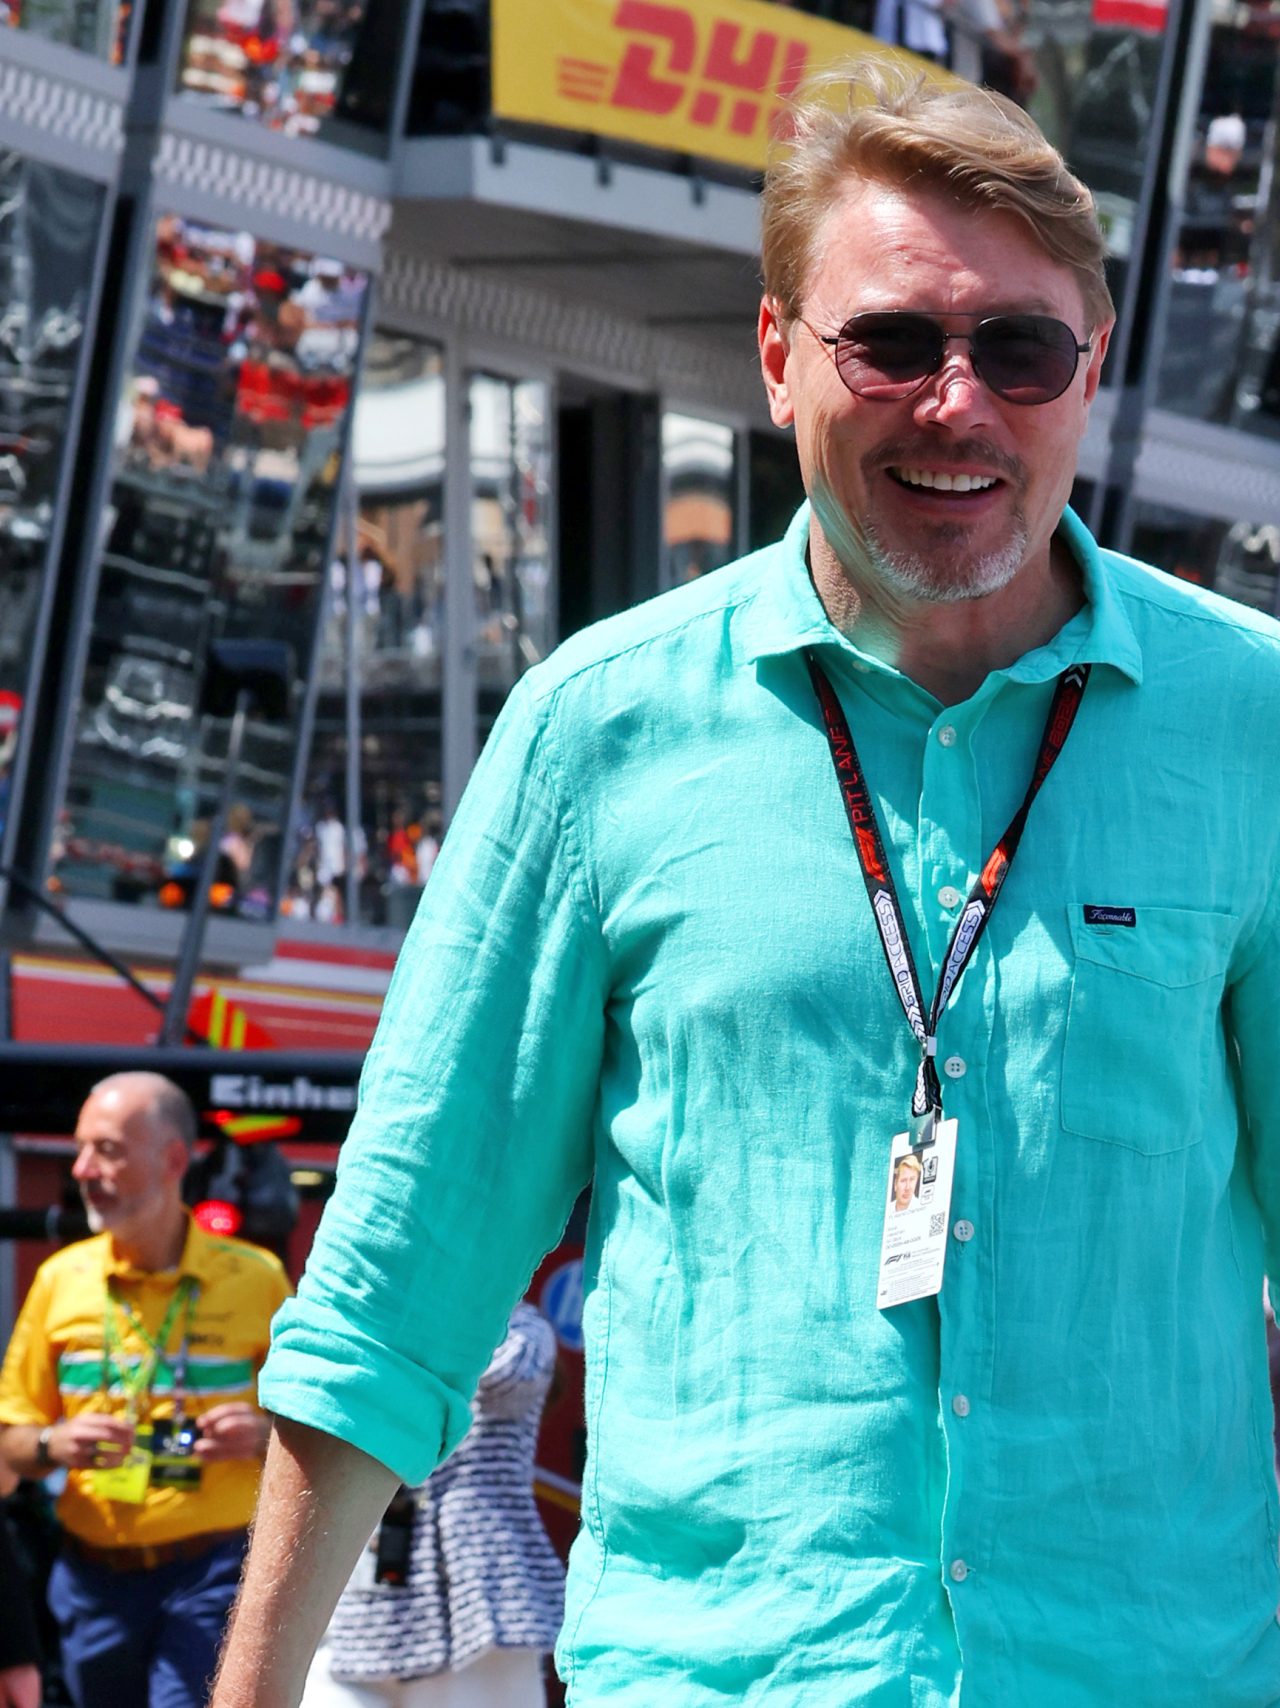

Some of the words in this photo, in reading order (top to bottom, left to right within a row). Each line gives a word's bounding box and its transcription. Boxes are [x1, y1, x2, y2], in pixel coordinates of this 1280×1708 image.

[829, 726, 860, 787] LANE
[1034, 748, 1056, 791] ANE
[845, 791, 869, 825] PIT
[878, 902, 905, 968] ACCESS
[949, 913, 979, 976] ACCESS
[210, 1074, 358, 1110] Einhe
